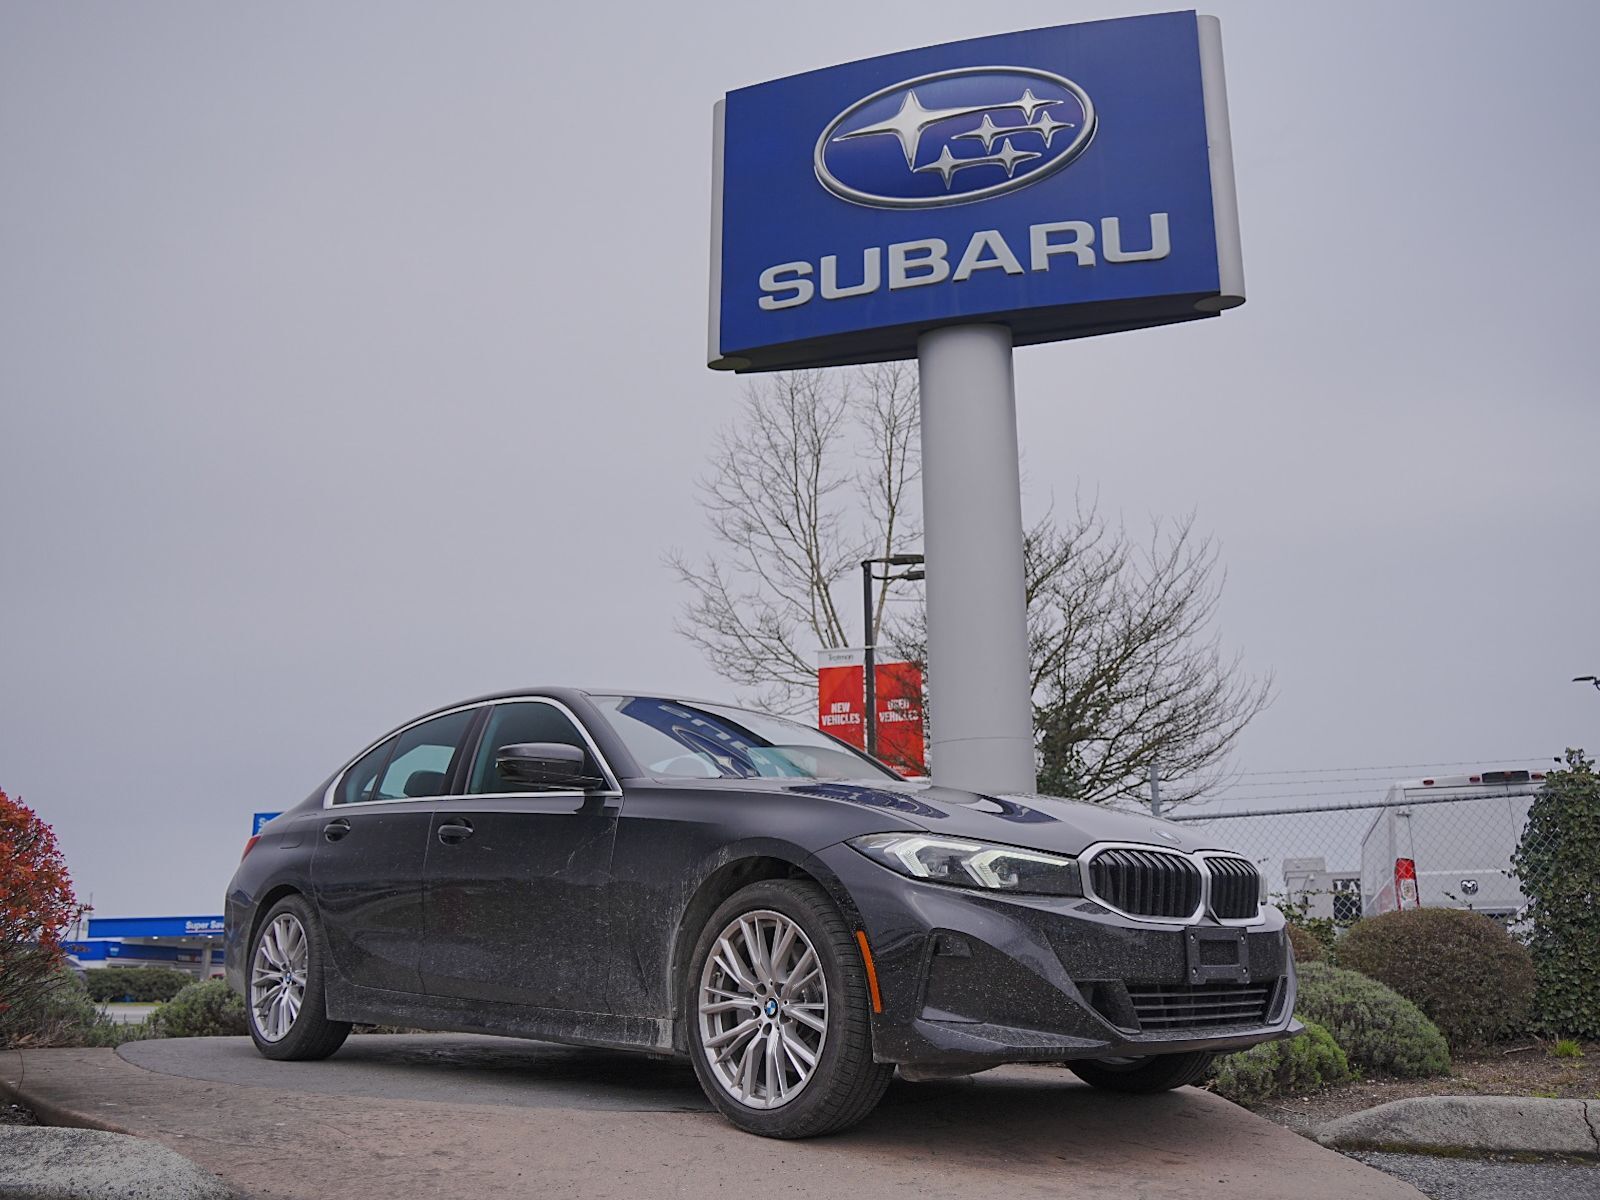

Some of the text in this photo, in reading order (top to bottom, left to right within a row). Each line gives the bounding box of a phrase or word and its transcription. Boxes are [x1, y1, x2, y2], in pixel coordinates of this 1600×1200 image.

[757, 212, 1171, 311] SUBARU
[831, 702, 850, 713] NEW
[821, 713, 860, 726] VEHICLES
[185, 920, 209, 931] Super
